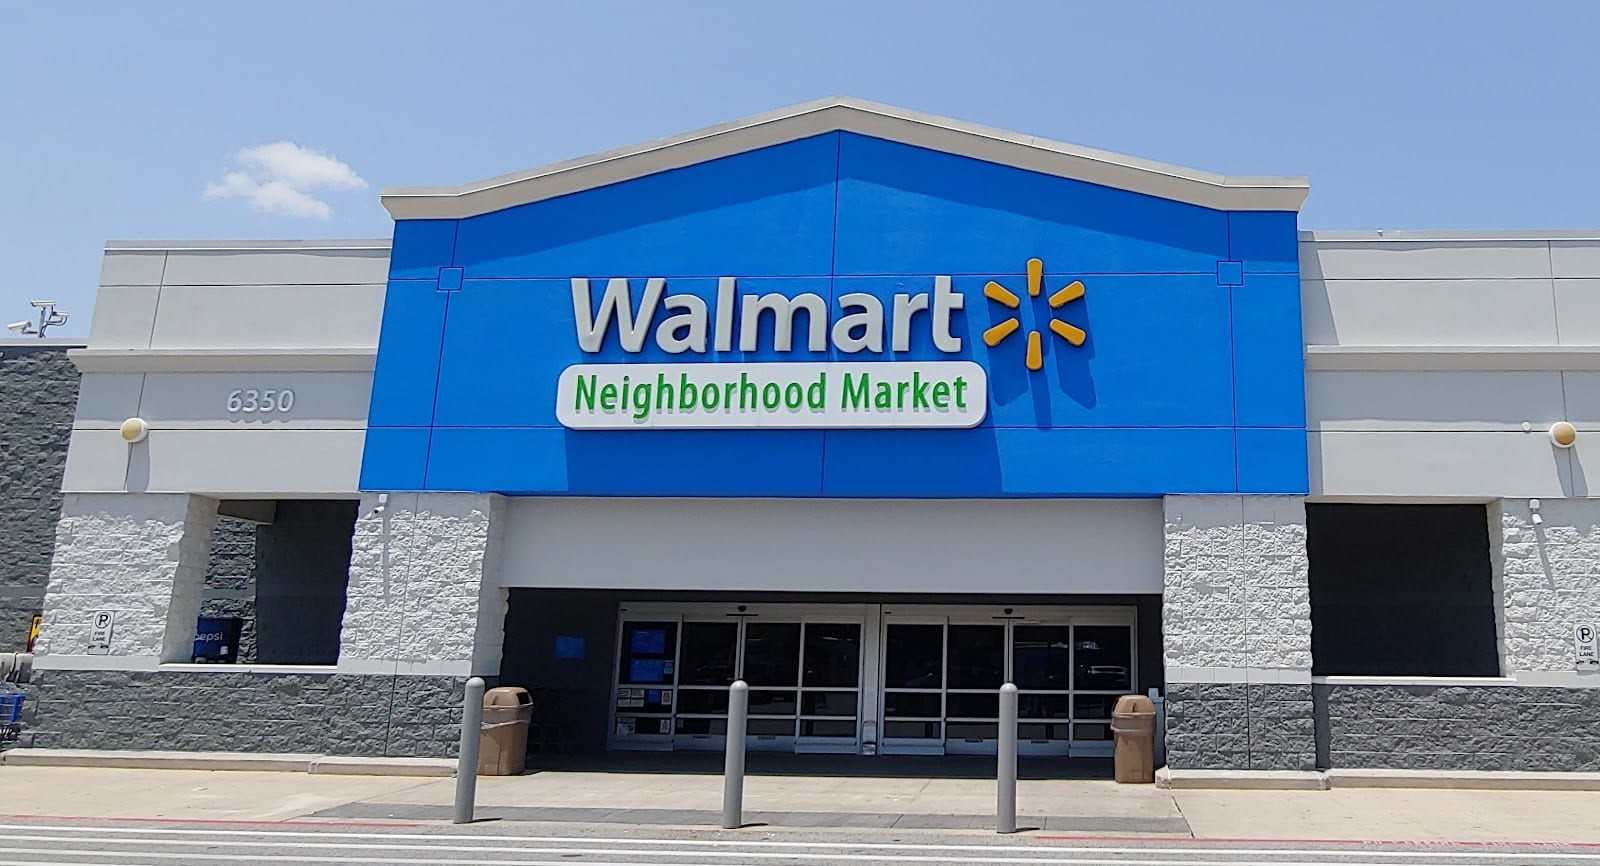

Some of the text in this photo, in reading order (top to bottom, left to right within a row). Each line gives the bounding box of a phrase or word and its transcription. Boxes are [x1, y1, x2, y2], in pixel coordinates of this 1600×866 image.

[570, 275, 965, 354] Walmart
[226, 388, 295, 412] 6350
[575, 372, 968, 419] Neighborhood Market
